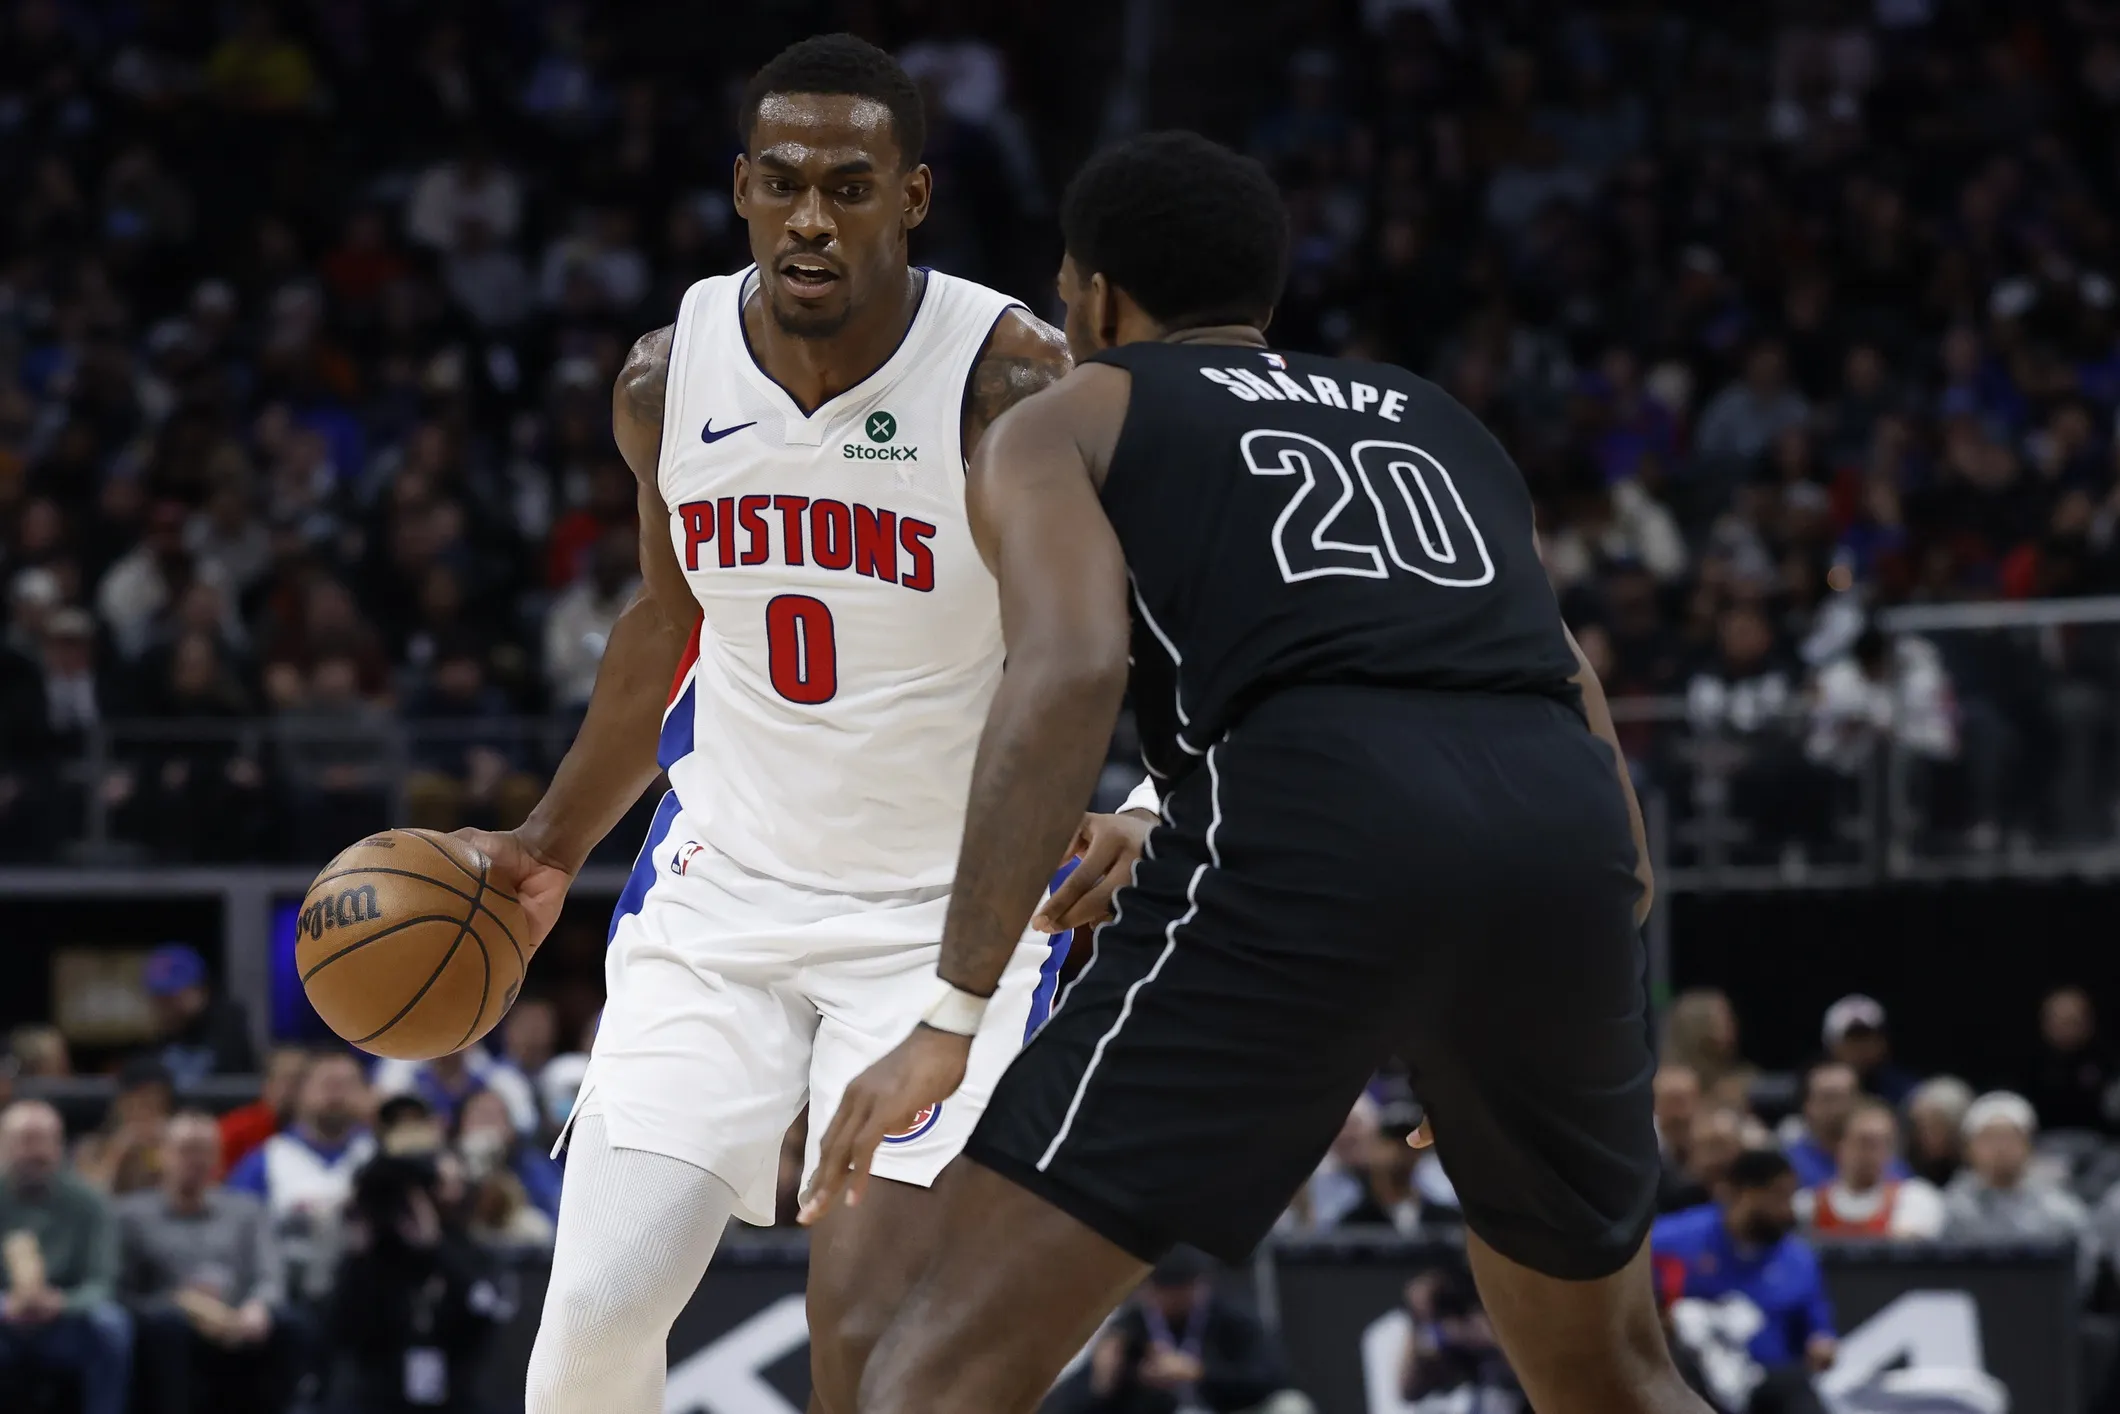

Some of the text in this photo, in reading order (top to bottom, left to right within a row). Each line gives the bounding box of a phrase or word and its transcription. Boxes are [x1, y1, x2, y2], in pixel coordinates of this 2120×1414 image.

[1199, 366, 1409, 423] SHARPE
[843, 444, 918, 462] StockX
[678, 494, 937, 593] PISTONS
[1239, 428, 1496, 588] 20
[765, 593, 838, 705] 0
